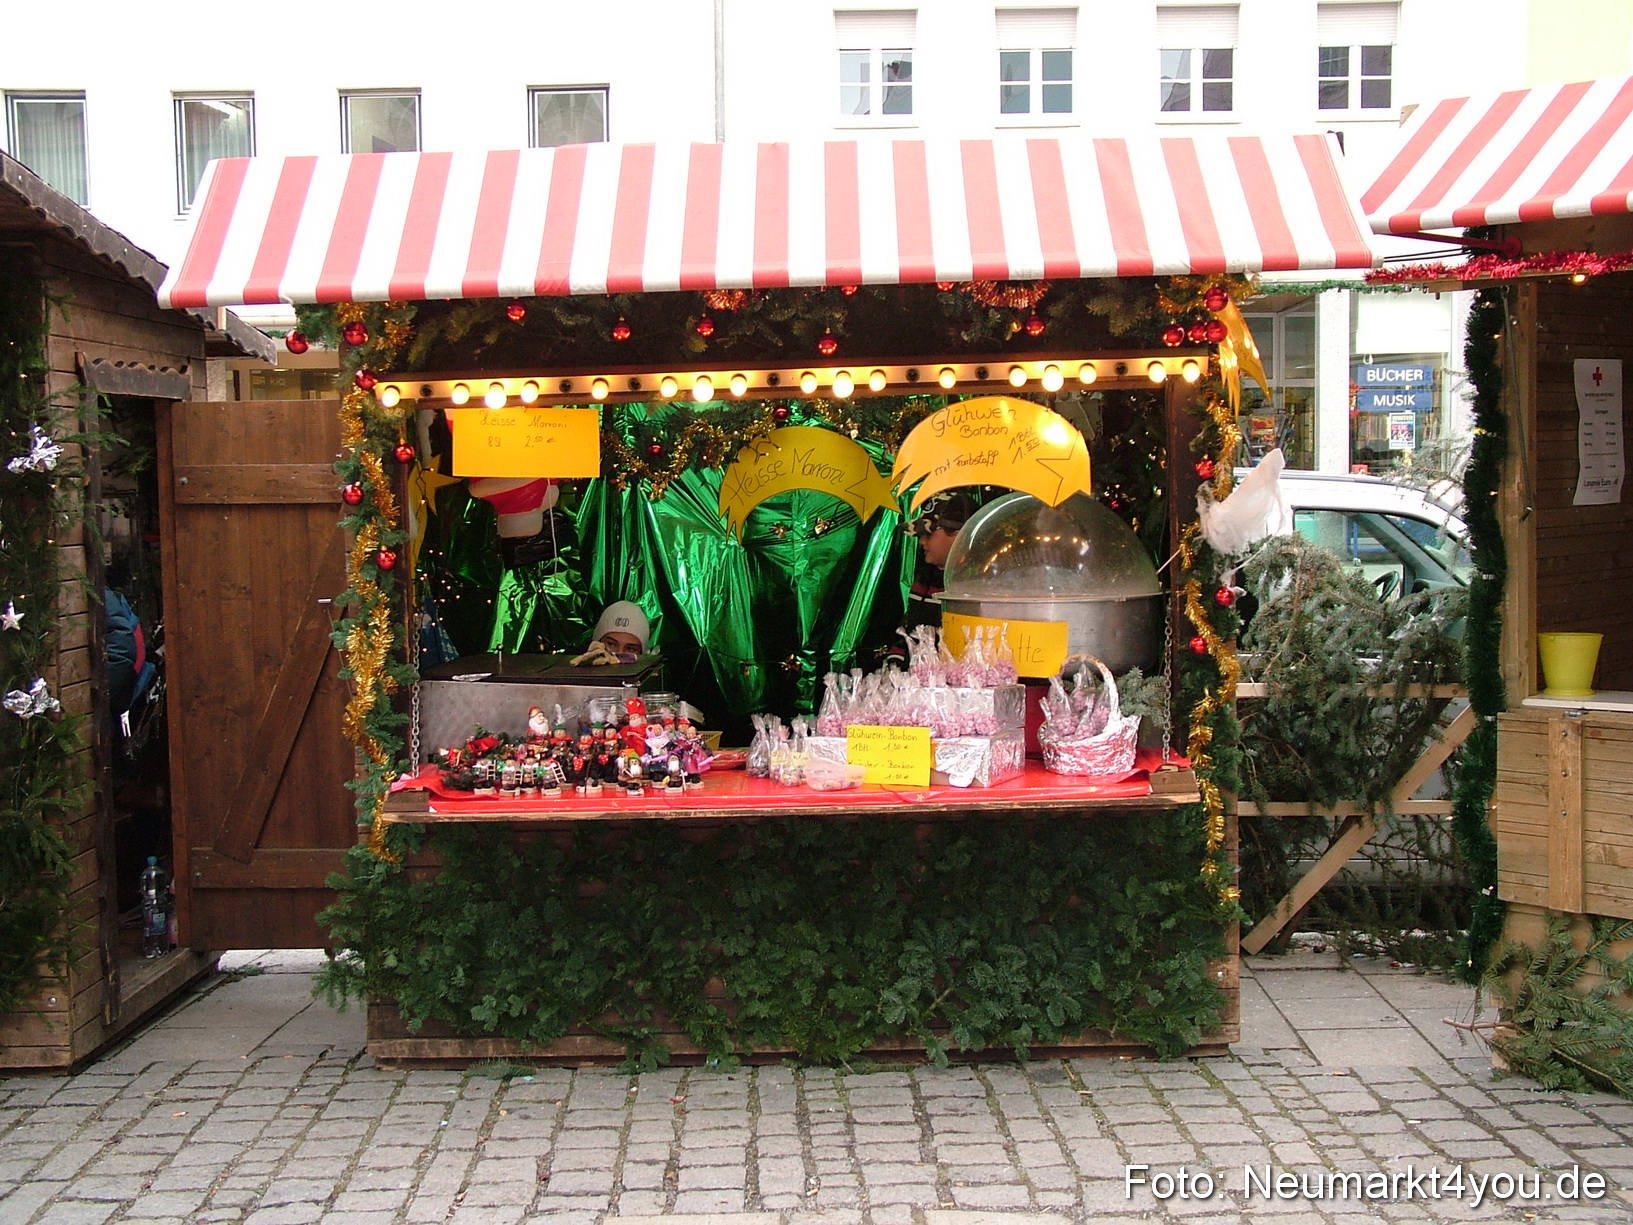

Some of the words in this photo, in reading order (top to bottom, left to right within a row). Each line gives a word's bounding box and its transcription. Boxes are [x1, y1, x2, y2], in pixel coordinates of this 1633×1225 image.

[1373, 394, 1416, 406] MUSIK
[959, 422, 1009, 439] Bonbon
[791, 447, 848, 485] Marroni
[887, 727, 918, 741] Bonbon
